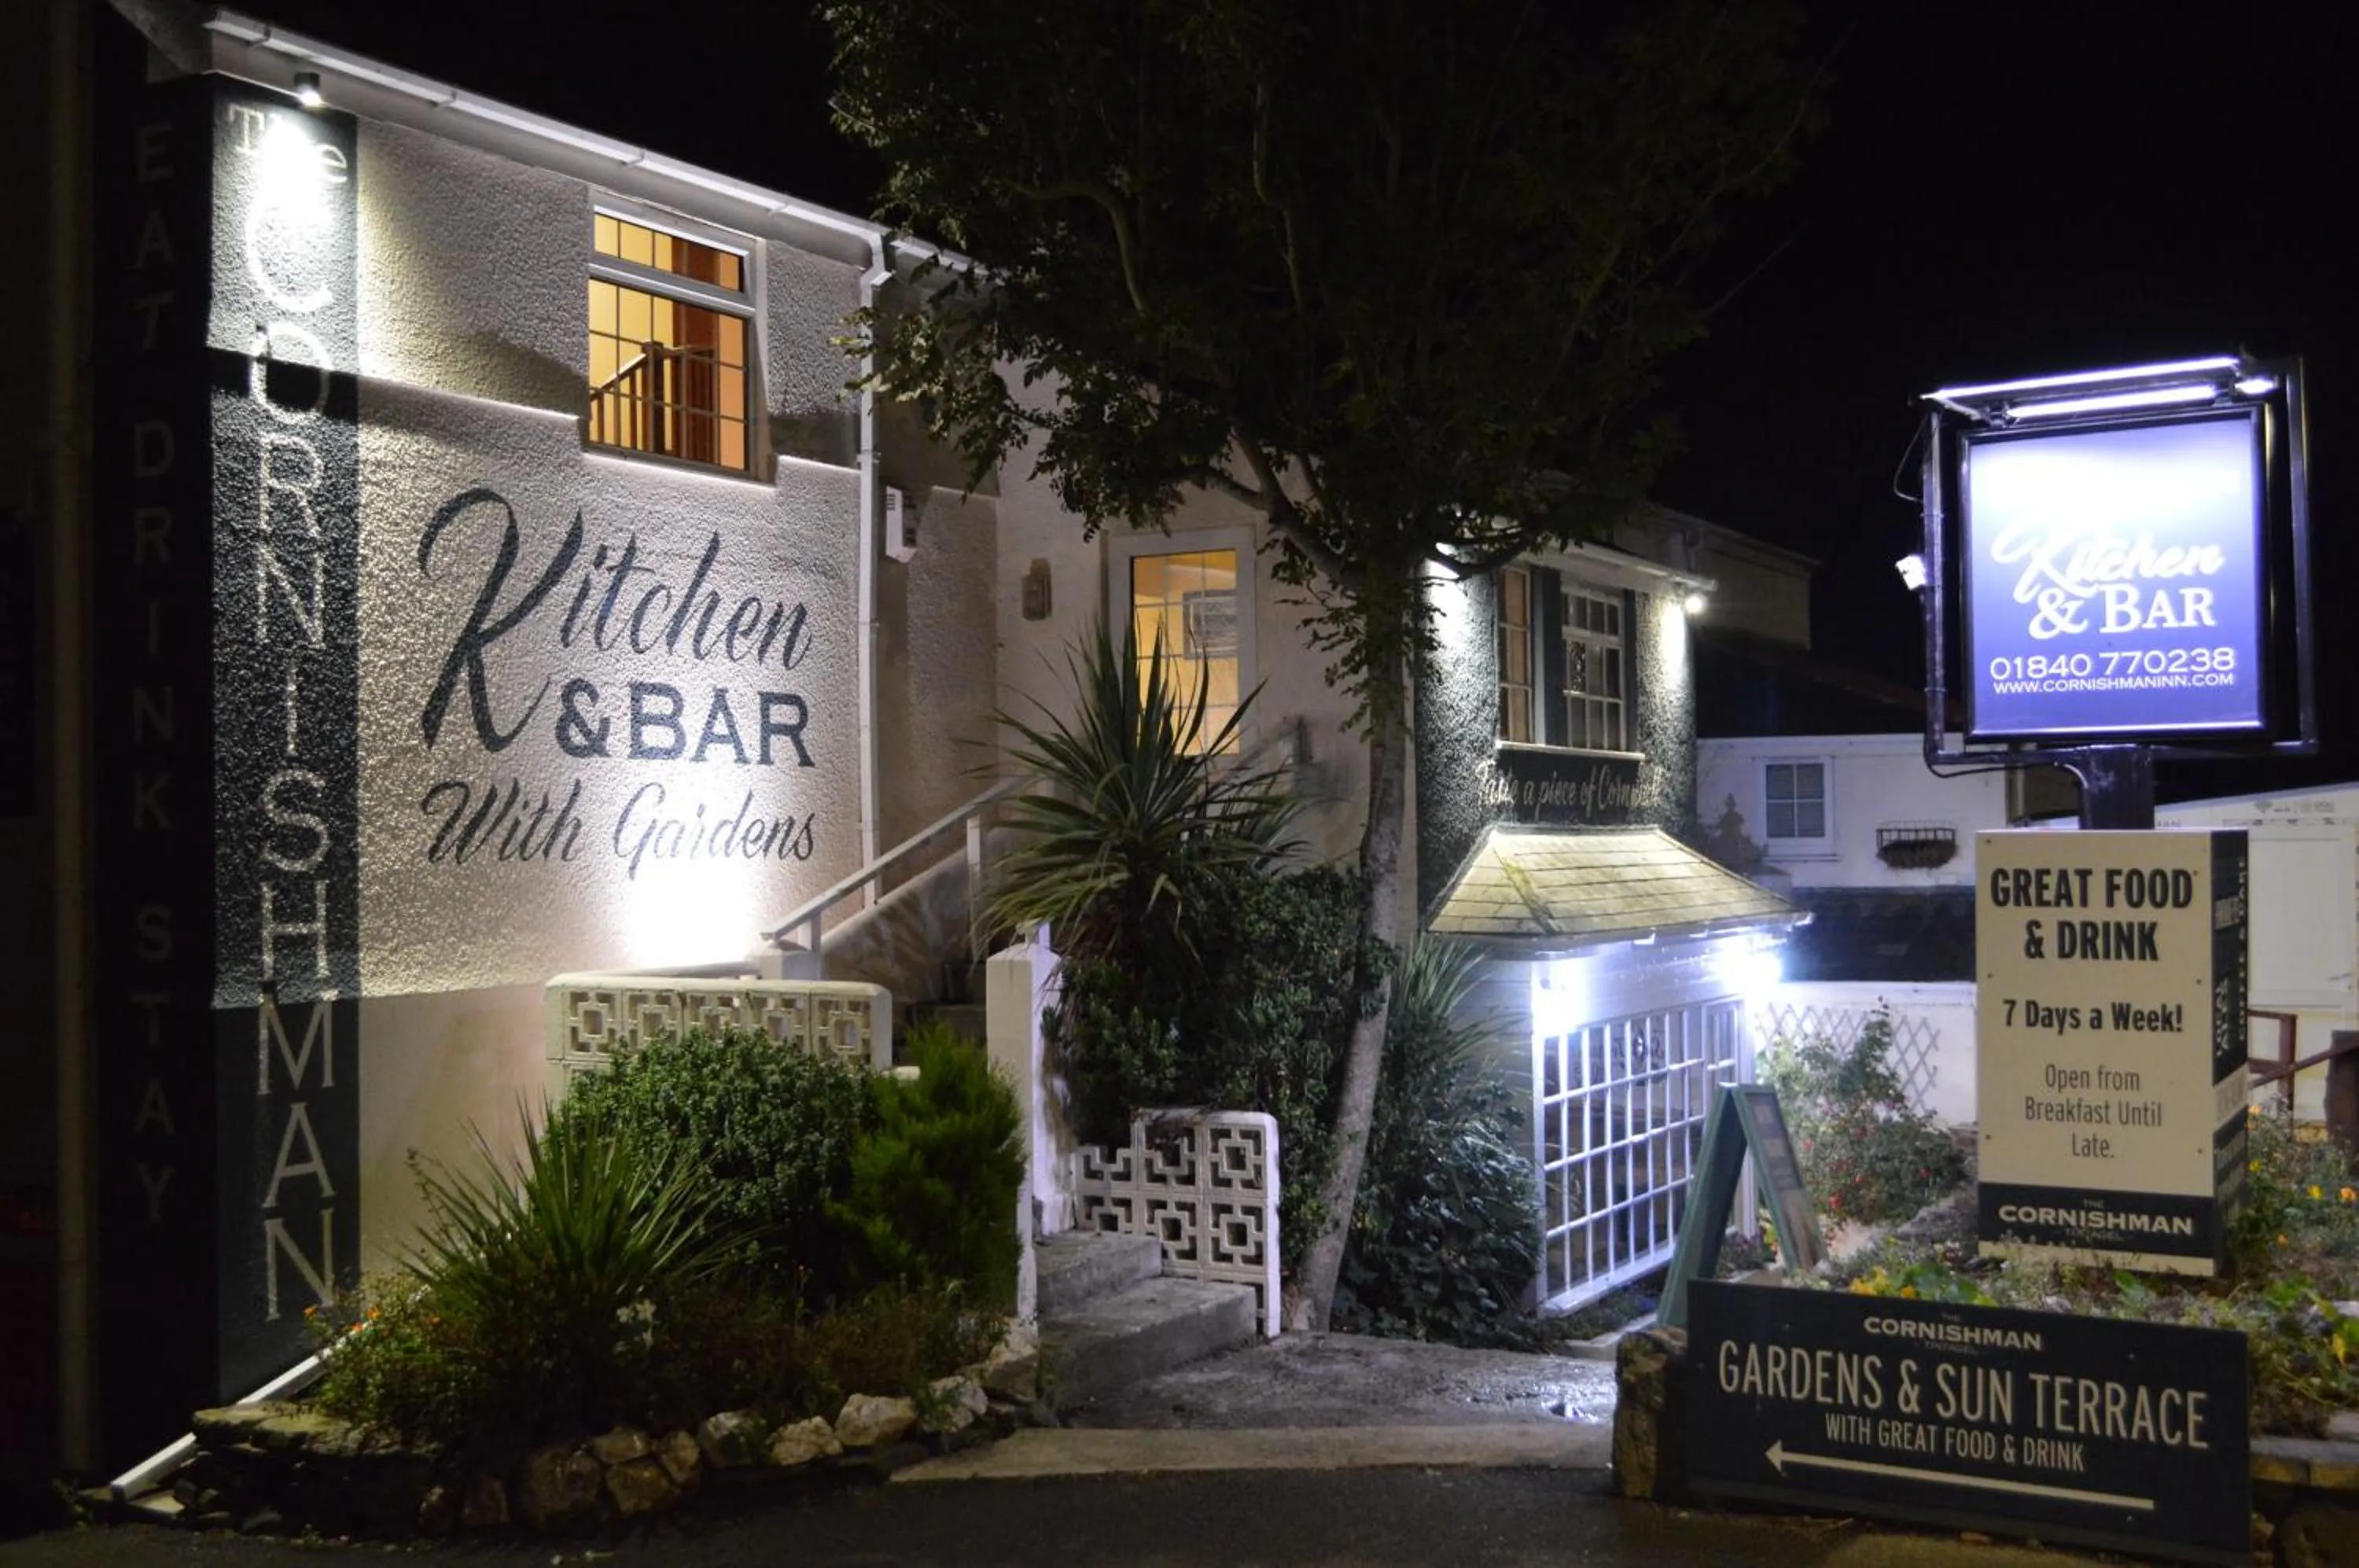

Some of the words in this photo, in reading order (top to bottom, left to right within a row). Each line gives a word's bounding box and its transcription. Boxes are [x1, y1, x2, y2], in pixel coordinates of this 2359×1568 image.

[229, 104, 348, 183] Te
[127, 121, 175, 352] EAT
[1990, 517, 2225, 604] Kitchen
[131, 421, 175, 832] DRINK
[418, 487, 813, 753] Kitchen
[2028, 586, 2089, 639] &
[2099, 583, 2217, 635] BAR
[1989, 653, 2092, 680] 01840
[2099, 647, 2236, 675] 770238
[1993, 673, 2235, 694] WWW.CORNISHMANINN.COM
[554, 677, 611, 759] &
[630, 681, 815, 767] BAR
[1522, 780, 1536, 805] a
[1535, 769, 1576, 822] piece
[1580, 764, 1598, 819] of
[421, 778, 583, 865] With
[613, 782, 815, 881] Gardens
[1989, 867, 2092, 907] GREAT
[2105, 868, 2193, 909] FOOD
[2023, 919, 2045, 959] &
[2056, 920, 2159, 961] DRINK
[2002, 999, 2017, 1027] 7
[2025, 999, 2081, 1036] Days
[2089, 1007, 2103, 1029] a
[2111, 1001, 2184, 1032] Week!
[128, 904, 175, 1225] STAY
[2044, 1063, 2091, 1093] Open
[2097, 1064, 2140, 1091] from
[2024, 1096, 2111, 1125] Breakfast
[2118, 1102, 2162, 1127] Until
[2071, 1132, 2115, 1159] Late.
[1998, 1204, 2194, 1235] CORNISHMAN
[1864, 1316, 2042, 1351] CORNISHMAN
[1718, 1339, 1883, 1410] GARDENS
[1897, 1358, 1921, 1415] &
[1935, 1362, 2013, 1426] SUN
[2028, 1371, 2210, 1449] TERRACE
[1825, 1412, 1871, 1445] WITH
[1878, 1419, 1938, 1454] GREAT
[1945, 1426, 1997, 1460] FOOD
[2003, 1434, 2016, 1464] &
[2022, 1437, 2085, 1473] DRINK
